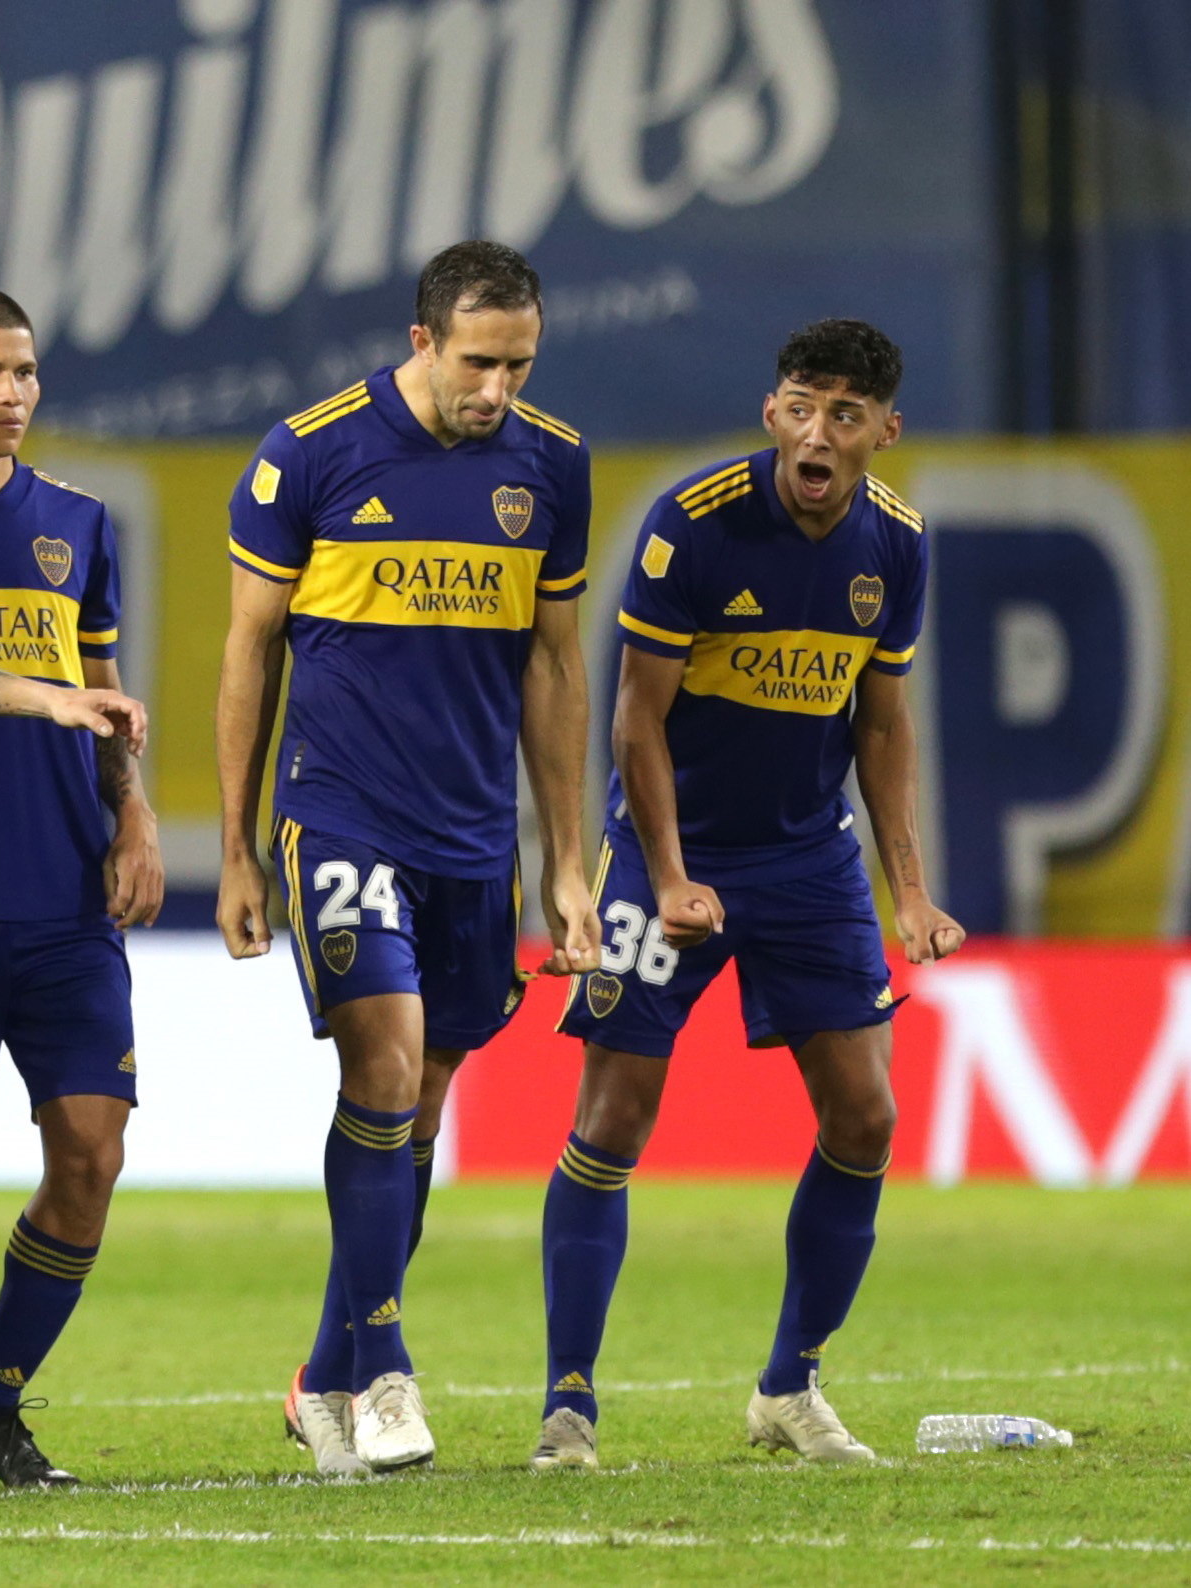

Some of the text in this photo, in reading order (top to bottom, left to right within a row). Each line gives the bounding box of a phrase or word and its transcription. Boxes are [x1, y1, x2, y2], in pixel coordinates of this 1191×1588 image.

[352, 512, 393, 524] adidas
[498, 503, 528, 516] CABJ
[372, 557, 504, 595] QATAR
[405, 593, 499, 615] AIRWAYS
[723, 605, 763, 616] adidas
[729, 646, 853, 681] QATAR
[752, 679, 845, 703] AIRWAYS
[313, 860, 400, 931] 24
[599, 899, 680, 986] 36
